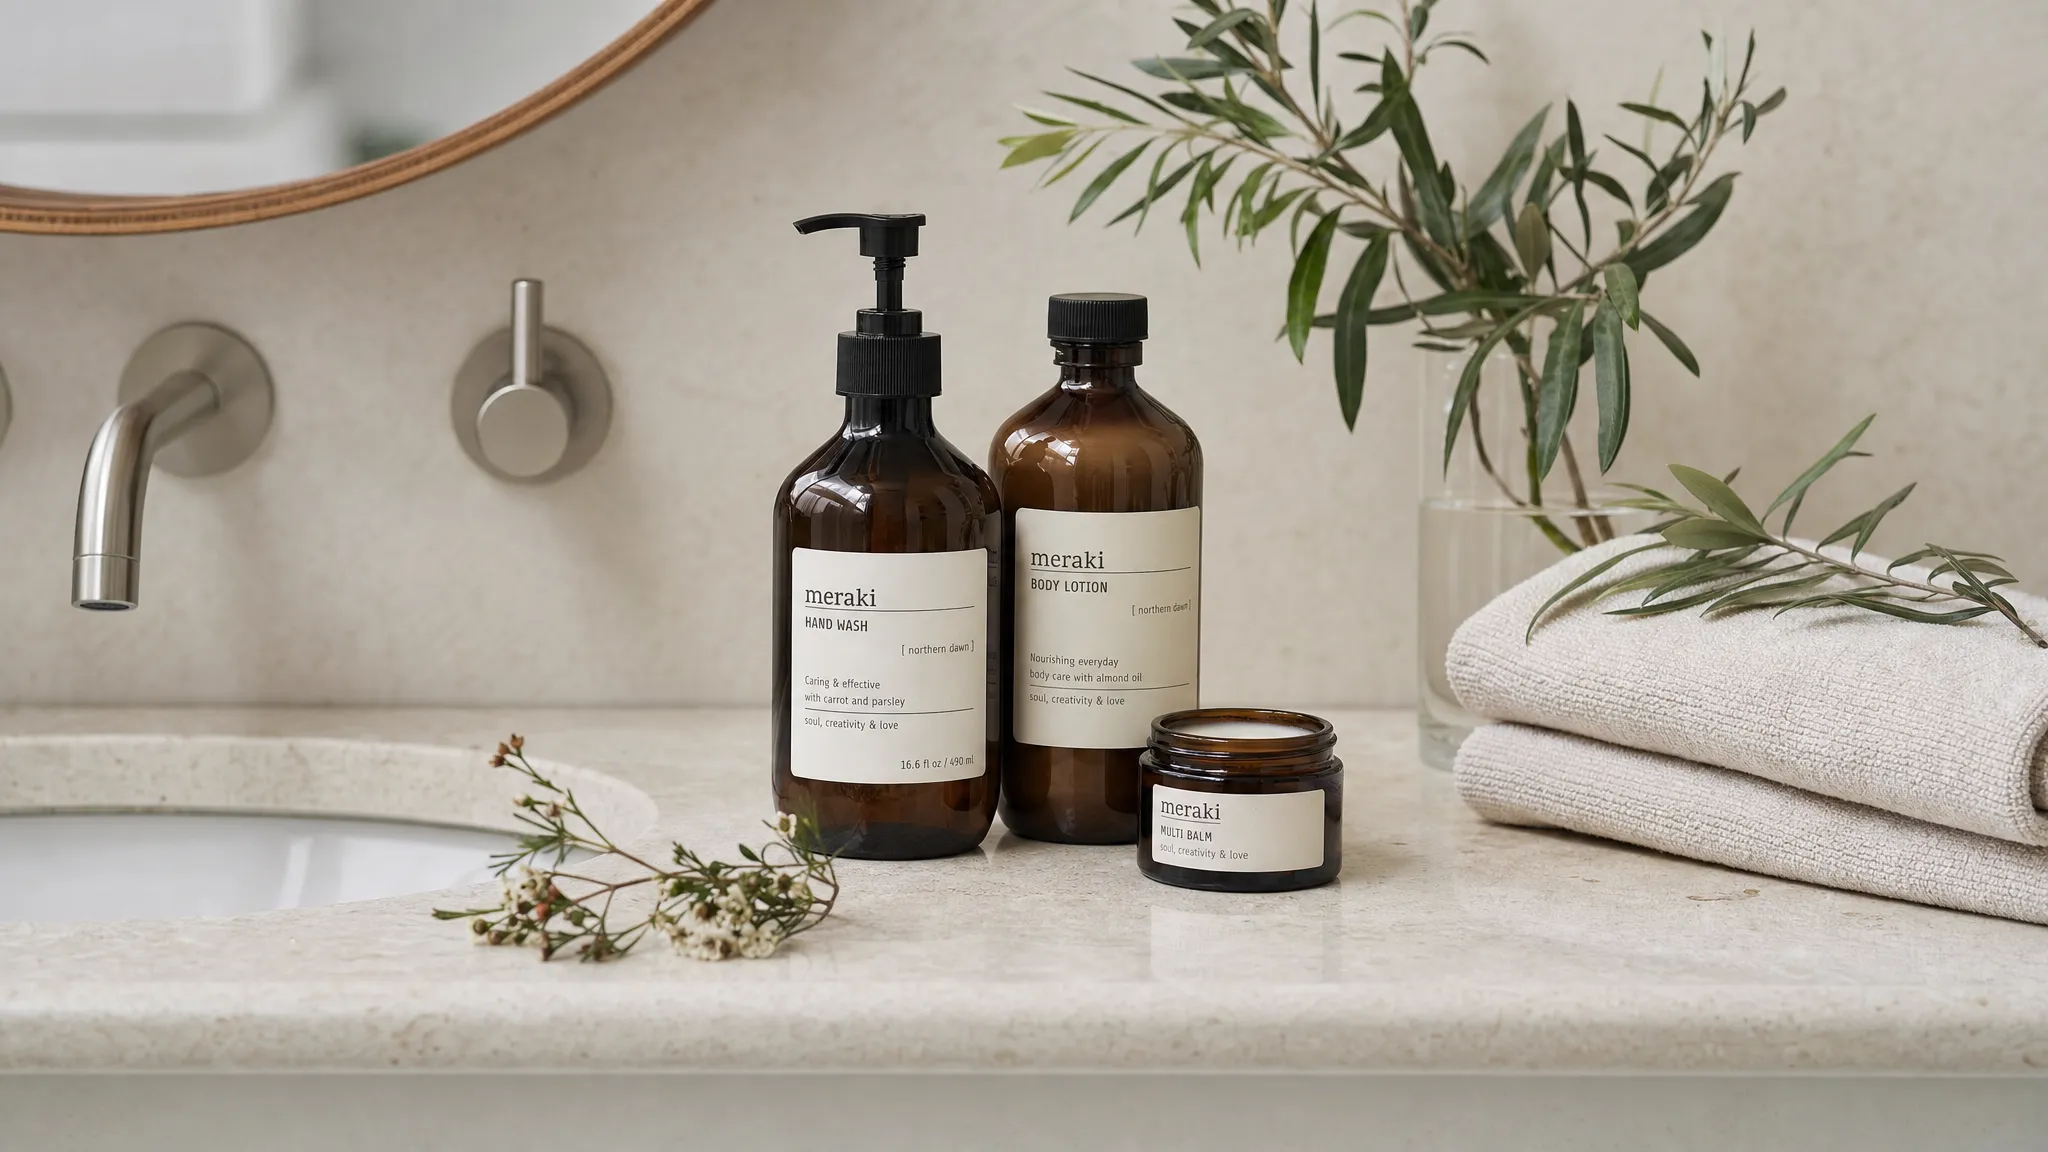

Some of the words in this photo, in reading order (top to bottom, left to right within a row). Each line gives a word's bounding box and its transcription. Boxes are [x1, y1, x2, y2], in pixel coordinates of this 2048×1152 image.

[1031, 551, 1104, 569] meraki
[1031, 578, 1059, 591] BODY
[1065, 580, 1108, 593] LOTION
[805, 588, 877, 607] meraki
[1138, 604, 1171, 615] northern
[805, 616, 833, 630] HAND
[837, 619, 868, 632] WASH
[908, 644, 946, 655] northern
[949, 643, 969, 653] dawn
[1030, 653, 1075, 667] Nourishing
[1078, 657, 1119, 668] everyday
[805, 676, 830, 689] Caring
[833, 678, 839, 688] &
[842, 679, 881, 690] effective
[1030, 670, 1049, 681] body
[1052, 673, 1070, 681] care
[1074, 673, 1093, 682] with
[1096, 673, 1129, 682] almond
[1132, 673, 1142, 682] oil
[805, 693, 821, 703] with
[823, 694, 848, 704] carrot
[852, 696, 868, 706] and
[872, 697, 905, 708] parsley
[1030, 693, 1049, 704] soul,
[1051, 695, 1093, 707] creativity
[1096, 696, 1103, 705] &
[1107, 696, 1125, 705] love
[805, 717, 822, 728] soul,
[825, 719, 865, 731] creativity
[869, 720, 876, 729] &
[880, 720, 898, 729] love
[901, 760, 920, 770] 16.6
[923, 759, 929, 769] fl
[932, 760, 941, 768] oz
[950, 757, 963, 766] 490
[965, 755, 974, 764] ml
[1161, 801, 1221, 820] meraki
[1160, 825, 1183, 838] MULTI
[1187, 830, 1212, 842] BALM
[1160, 843, 1175, 854] soul,
[1178, 847, 1216, 859] creativity
[1220, 850, 1226, 859] &
[1230, 851, 1248, 859] love
